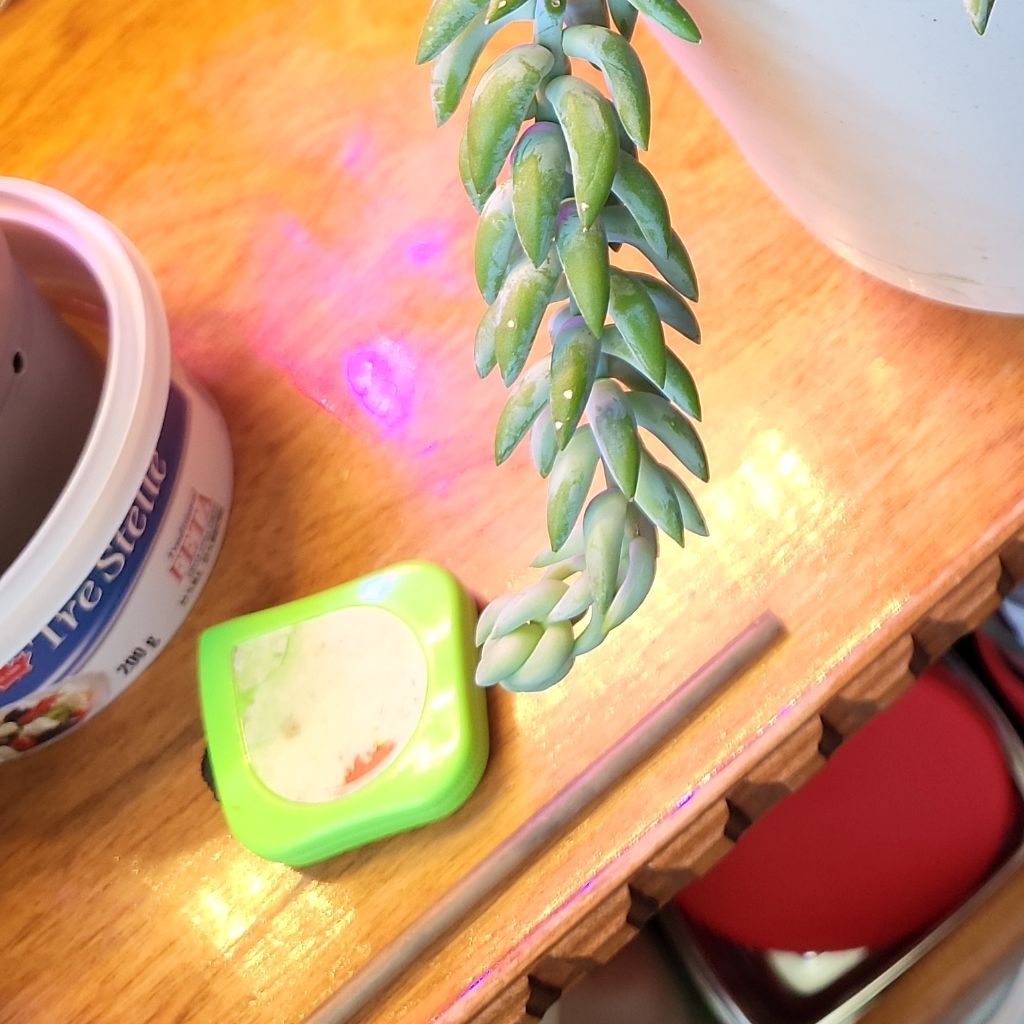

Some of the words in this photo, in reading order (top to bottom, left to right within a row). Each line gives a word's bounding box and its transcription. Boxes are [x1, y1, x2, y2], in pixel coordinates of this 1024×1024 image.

[40, 579, 103, 650] Tre
[96, 450, 167, 584] Stelle
[117, 647, 148, 676] 200
